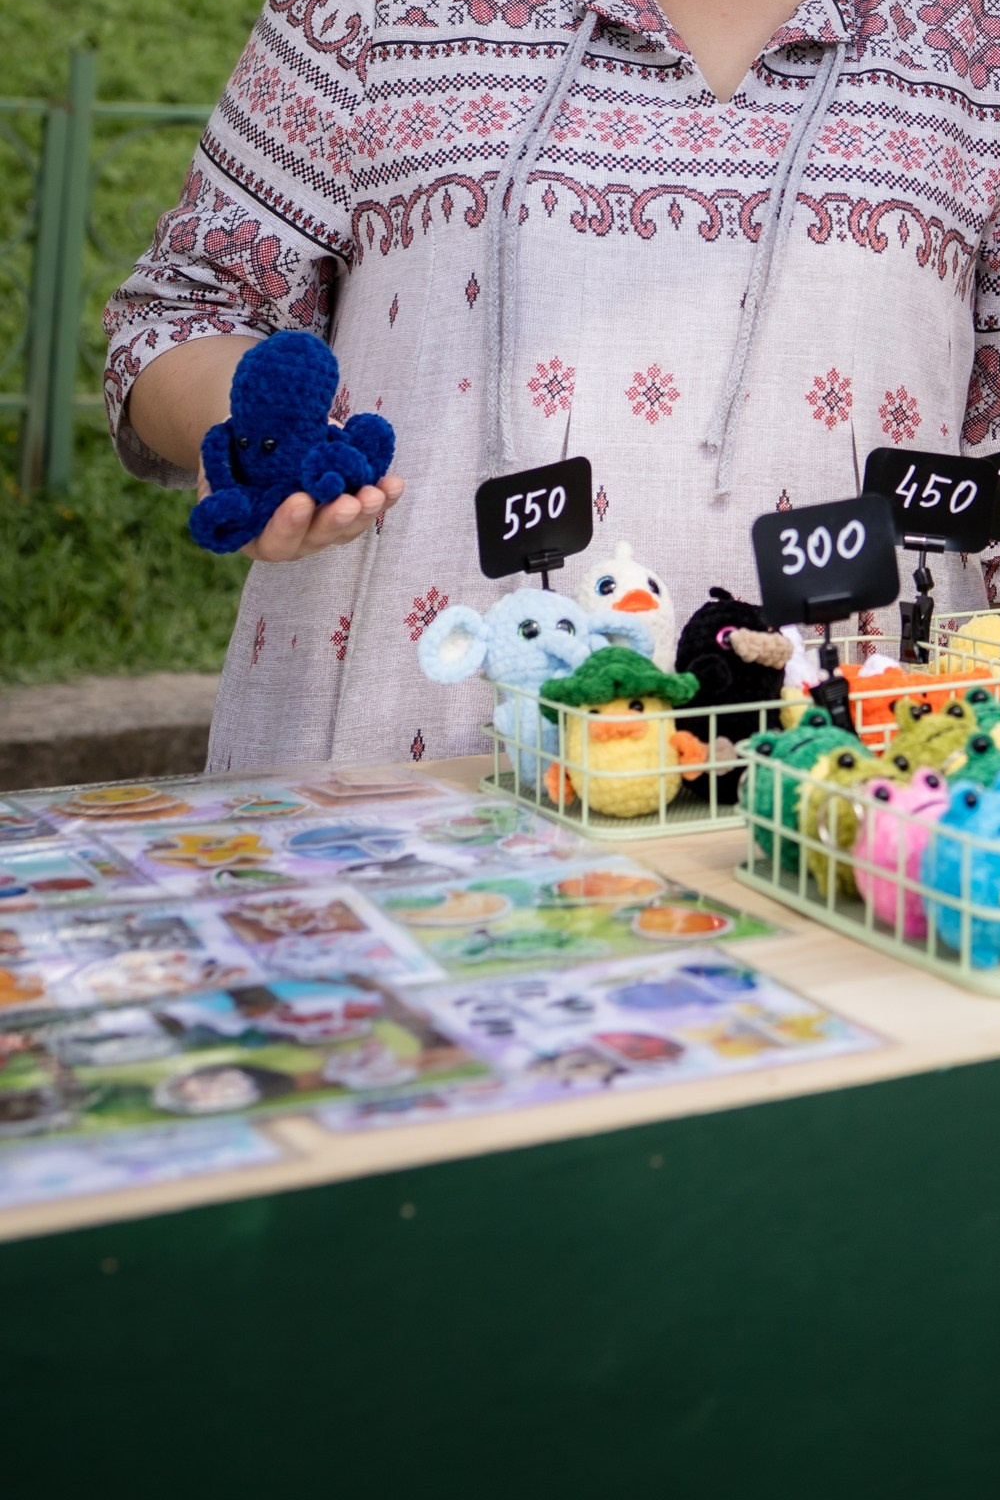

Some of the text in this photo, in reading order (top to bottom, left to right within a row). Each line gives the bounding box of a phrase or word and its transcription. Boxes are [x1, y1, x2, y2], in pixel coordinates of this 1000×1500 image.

[502, 485, 567, 540] 550
[894, 464, 978, 514] 450
[779, 519, 866, 576] 300
